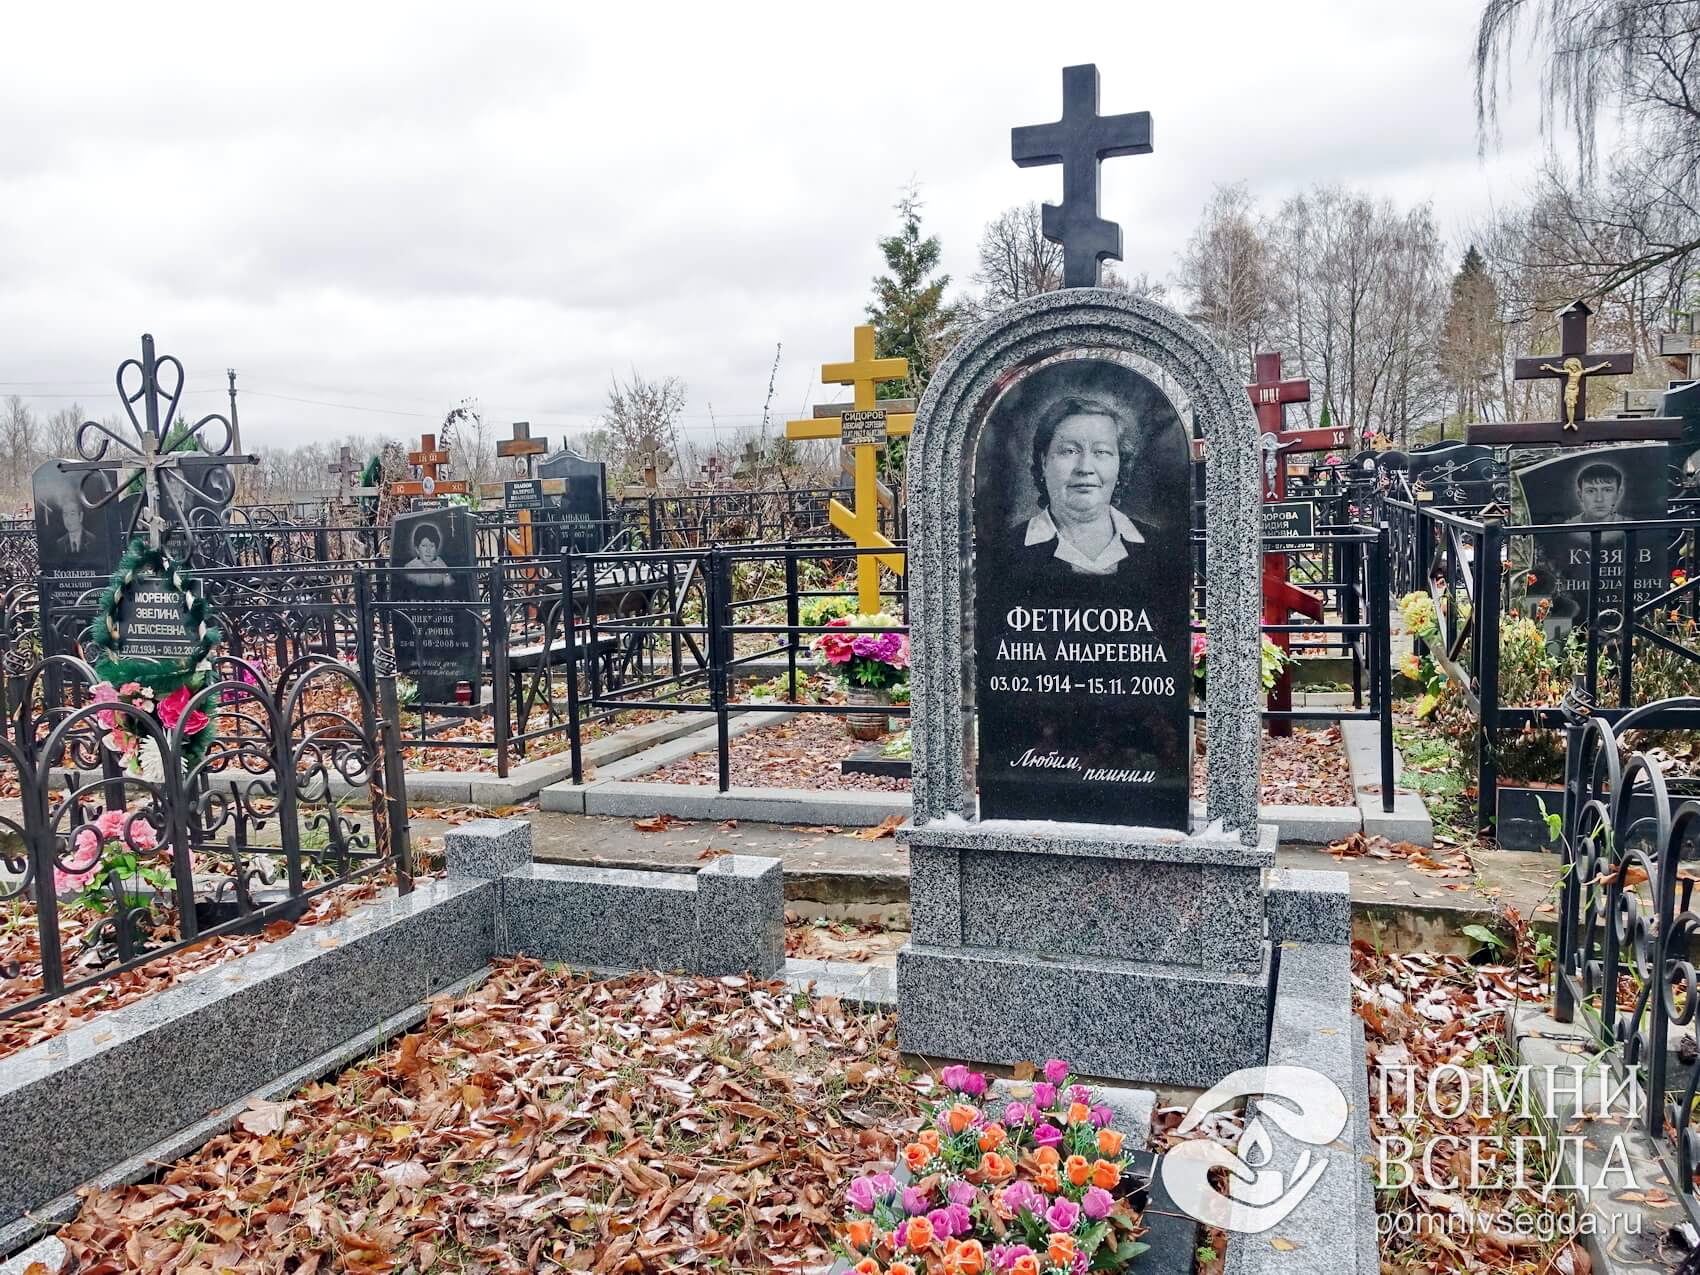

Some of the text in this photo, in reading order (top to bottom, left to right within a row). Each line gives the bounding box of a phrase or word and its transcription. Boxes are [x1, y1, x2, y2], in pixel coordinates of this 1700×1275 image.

[844, 411, 884, 421] СИДОРОВ
[1569, 548, 1652, 565] КУЗЯВ
[1566, 579, 1662, 591] НИОЛАВИЧ
[134, 591, 180, 604] МОРЕНКО
[135, 607, 180, 620] ЭВЕЛИНА
[1006, 606, 1153, 632] ФЕТИСОВА
[127, 623, 187, 636] АЛЕКСЕЕВНА
[996, 639, 1168, 663] АННА АНДРЕЕВНА
[1130, 676, 1176, 697] 2008
[1010, 748, 1083, 772] Любим,
[1082, 767, 1156, 784] помним
